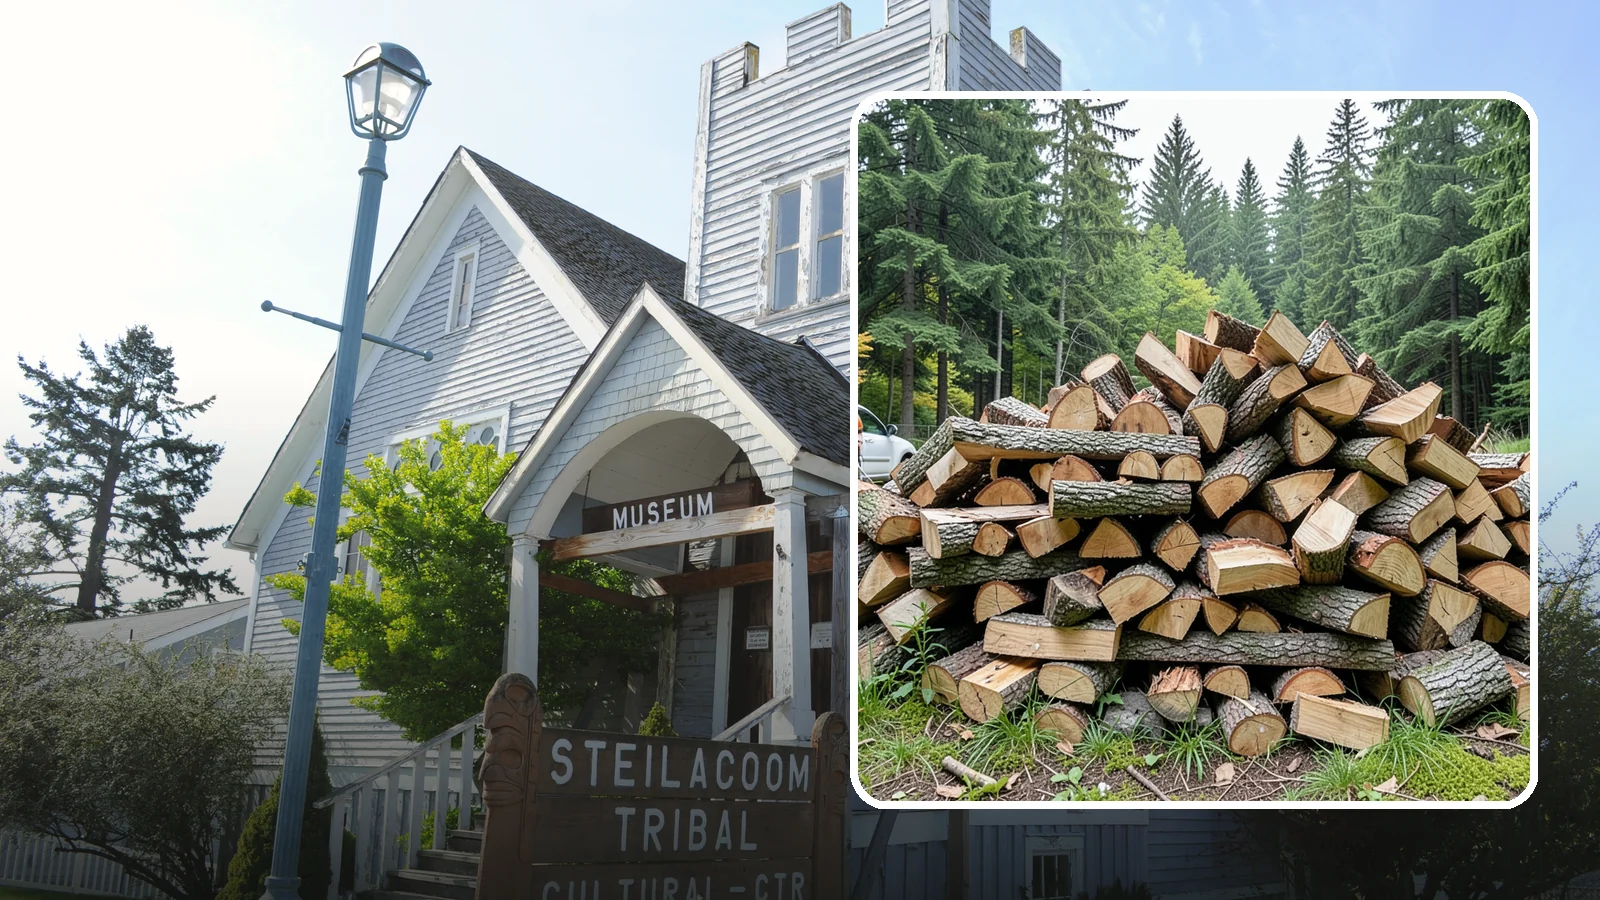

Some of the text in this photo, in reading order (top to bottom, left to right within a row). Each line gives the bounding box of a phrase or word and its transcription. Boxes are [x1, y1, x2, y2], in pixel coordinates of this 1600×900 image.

[613, 491, 714, 530] MUSEUM
[551, 739, 810, 792] STEILACOOM
[615, 807, 758, 852] TRIBAL
